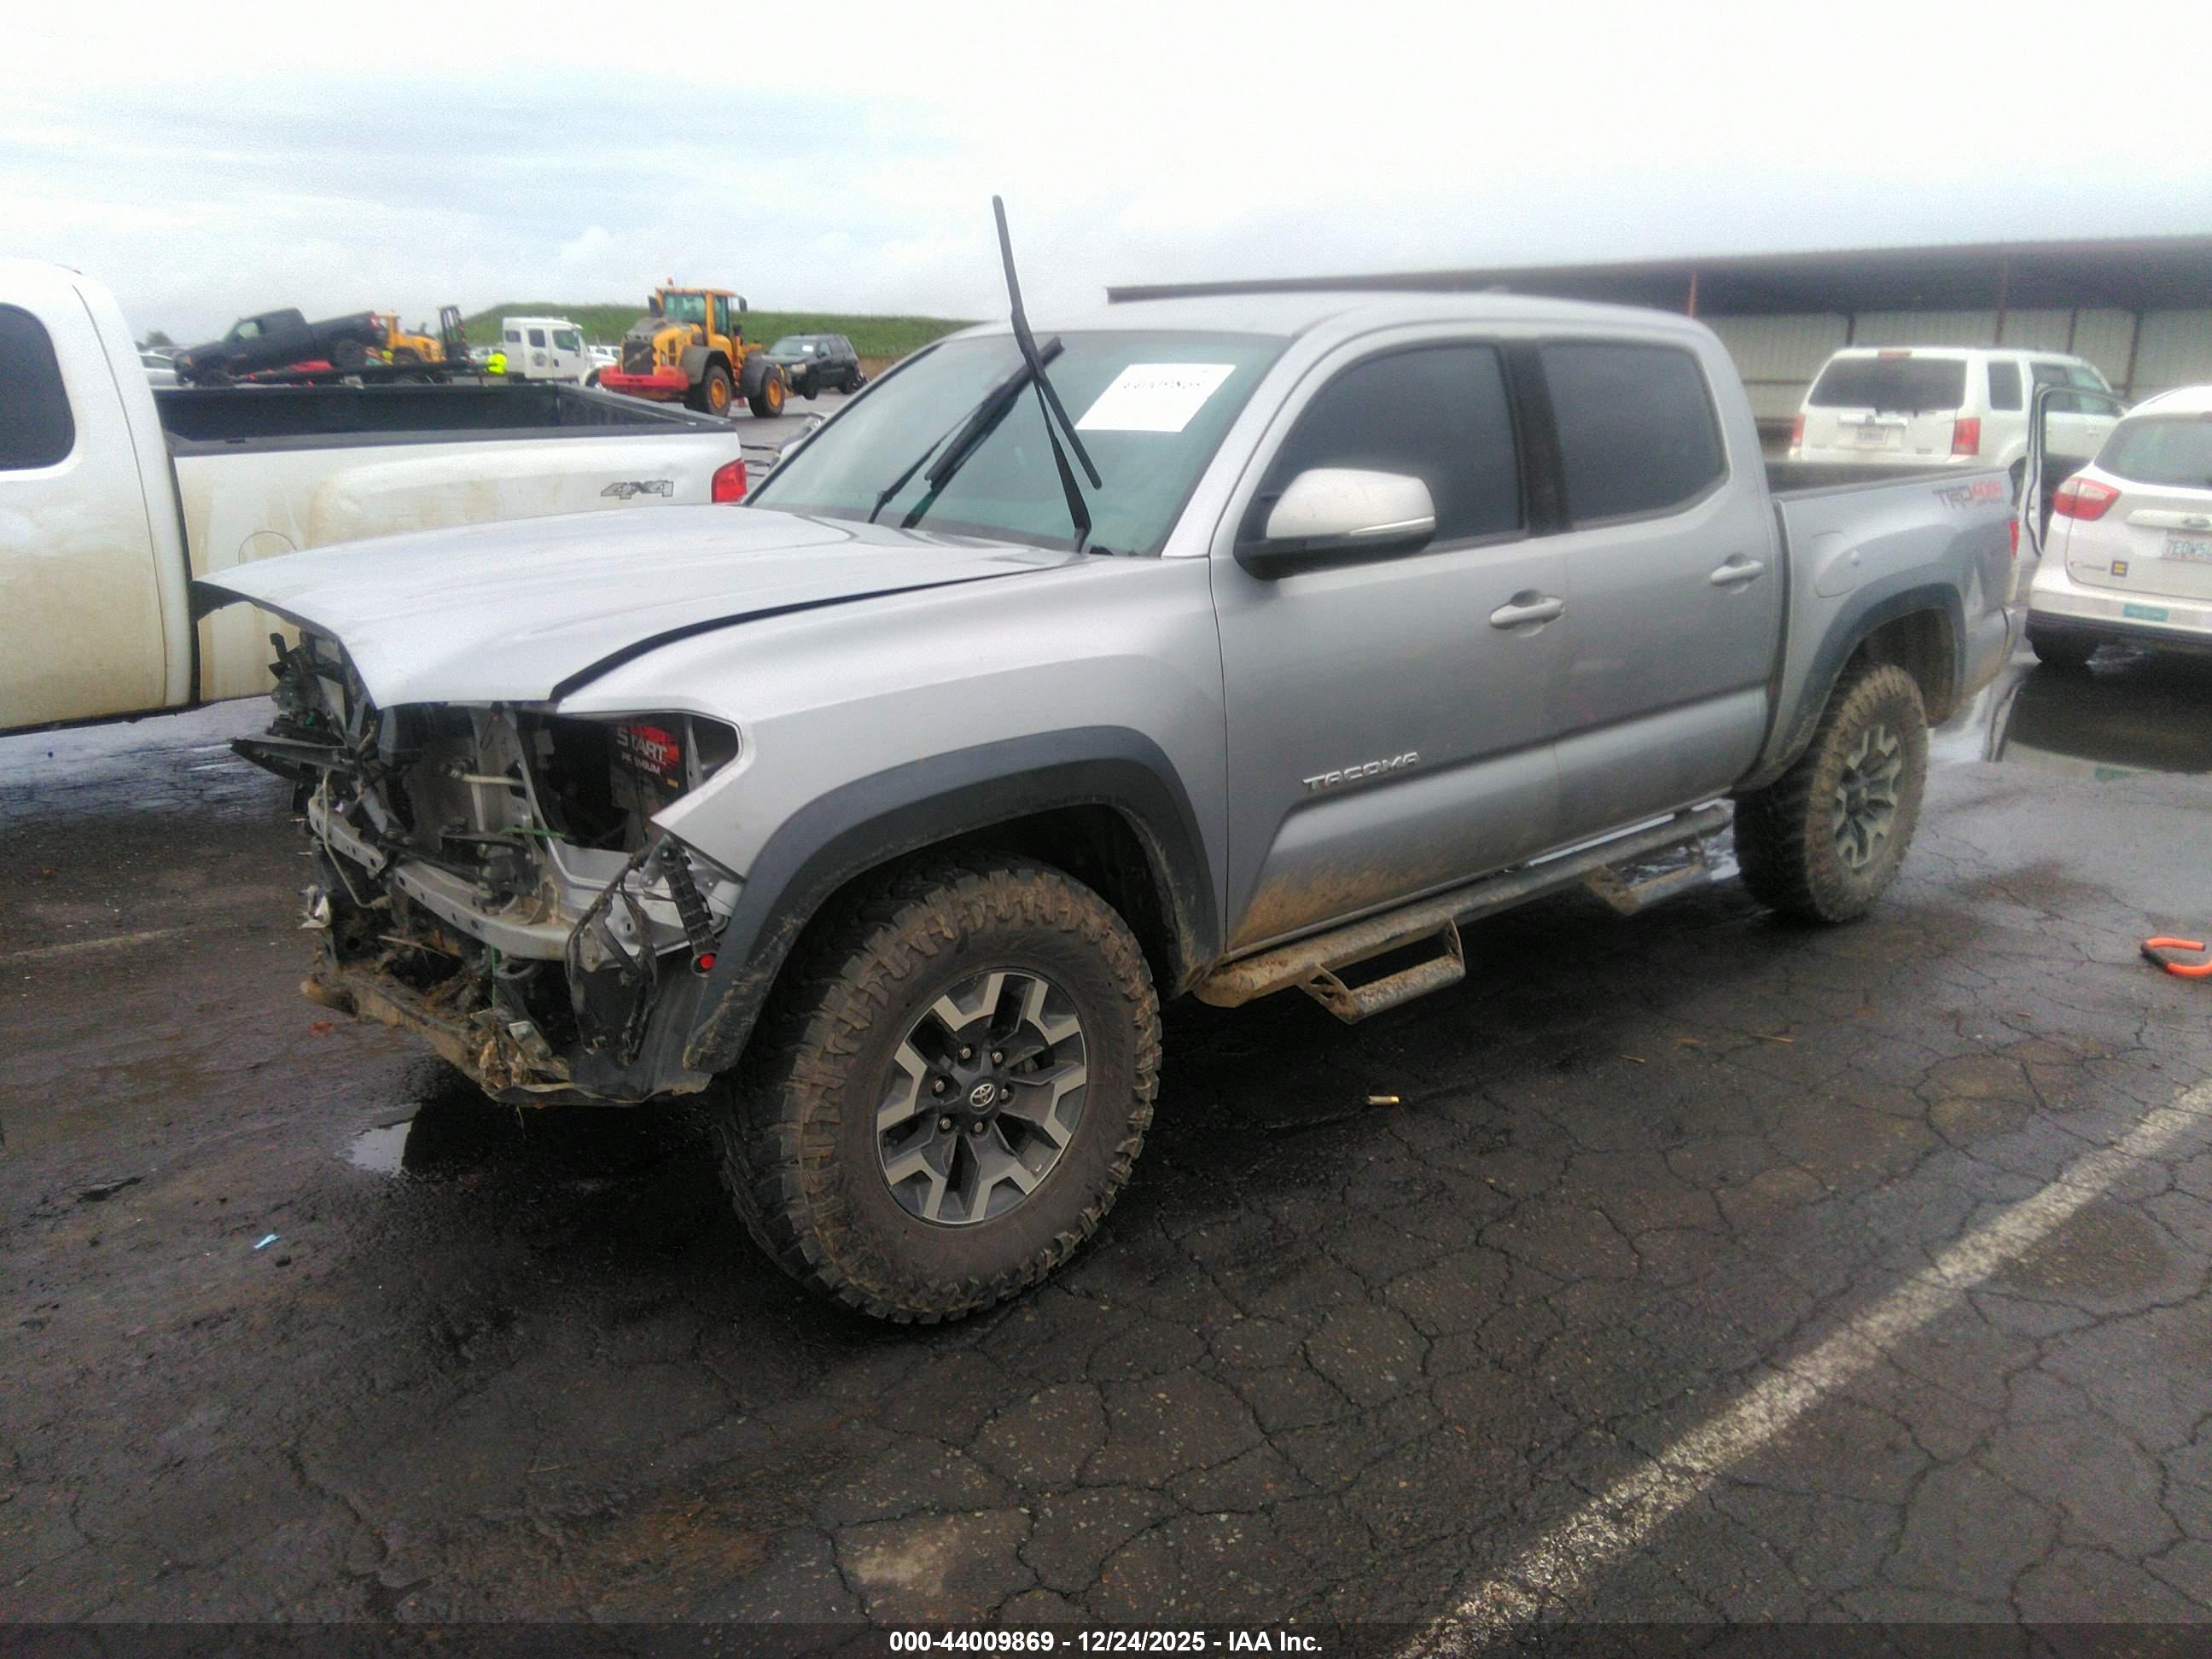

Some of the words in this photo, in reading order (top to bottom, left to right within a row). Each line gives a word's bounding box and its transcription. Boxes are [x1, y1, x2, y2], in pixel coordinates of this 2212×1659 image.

[616, 726, 668, 765] START
[621, 751, 661, 776] PRMIUM
[1301, 751, 1421, 790] TACOMA
